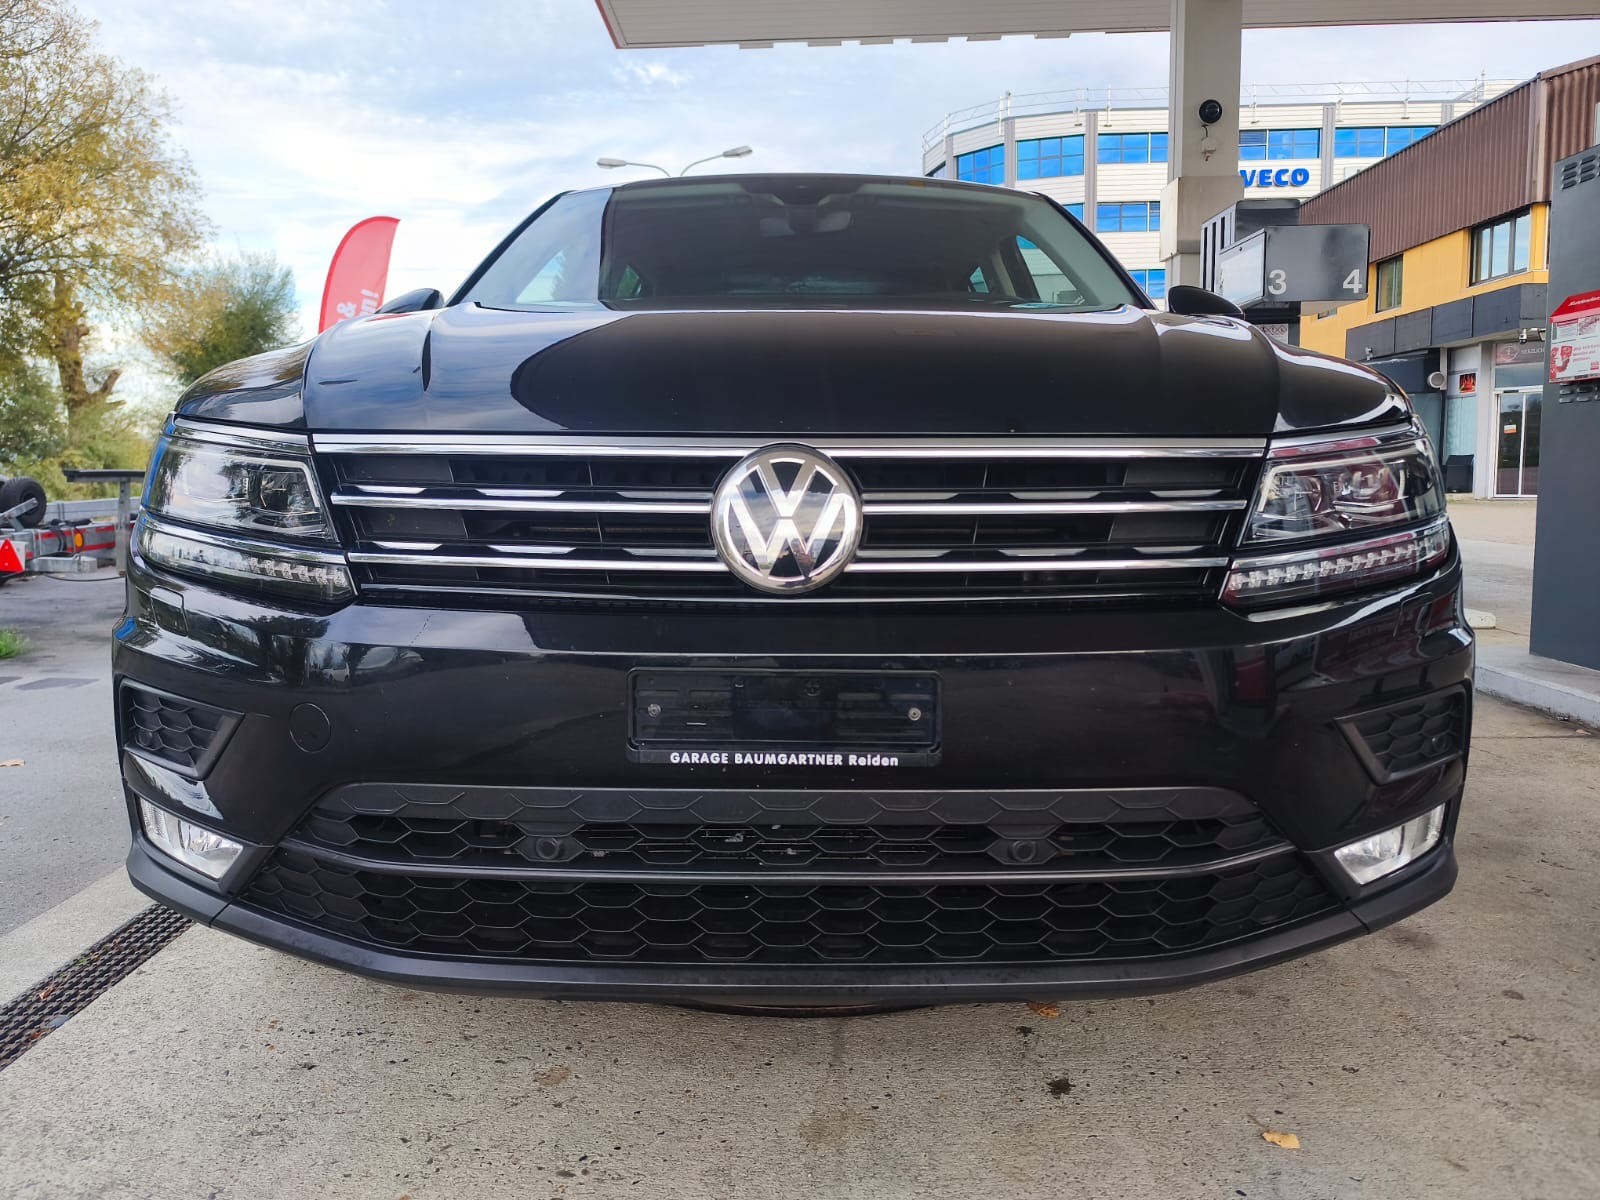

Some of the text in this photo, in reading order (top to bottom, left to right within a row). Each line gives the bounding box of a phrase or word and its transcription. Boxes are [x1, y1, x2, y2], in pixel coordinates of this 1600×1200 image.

[1239, 167, 1310, 188] VECO
[1267, 269, 1288, 296] 3
[1342, 268, 1363, 294] 4
[717, 449, 857, 587] VW
[670, 752, 899, 767] GARAGE BAUMGARTNER Reiden
